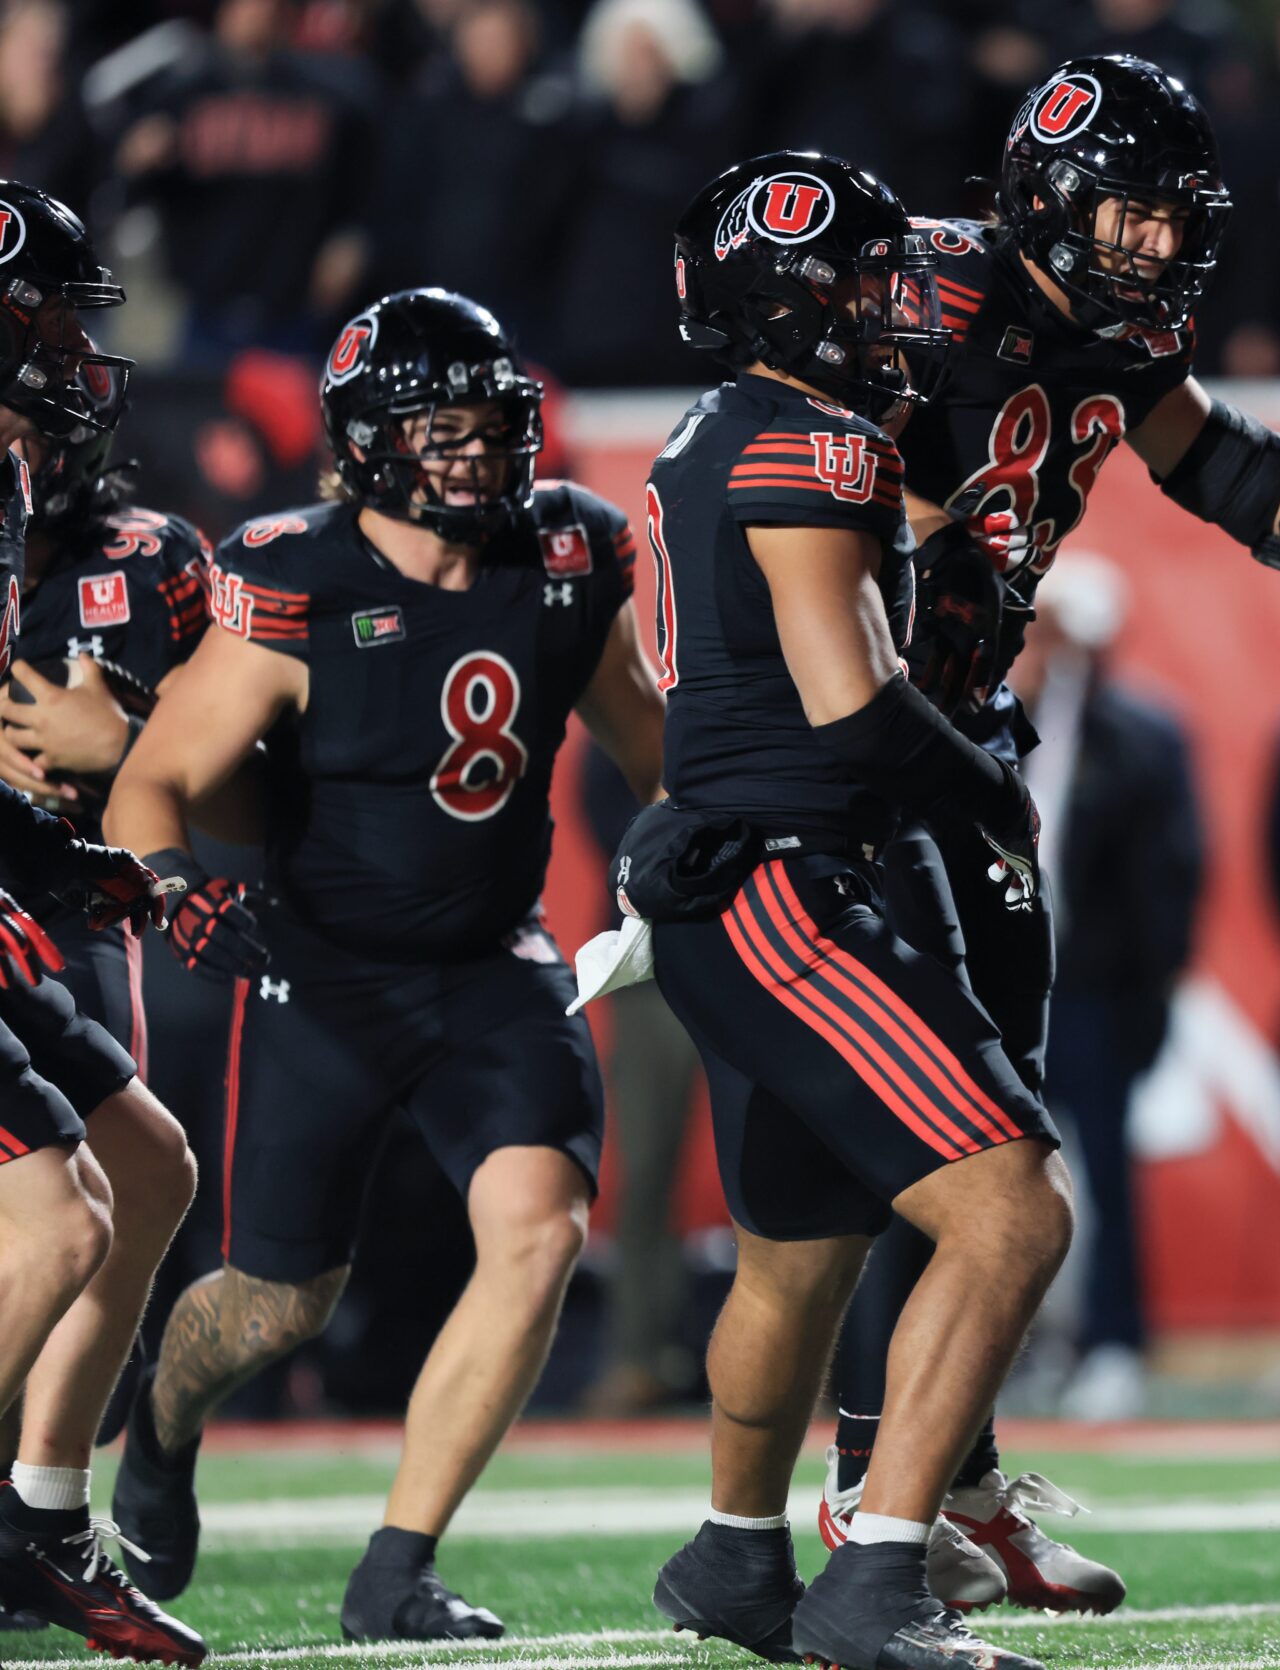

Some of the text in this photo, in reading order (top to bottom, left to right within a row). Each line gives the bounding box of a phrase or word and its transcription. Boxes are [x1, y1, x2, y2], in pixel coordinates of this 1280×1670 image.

[1038, 81, 1095, 135] U
[762, 182, 824, 235] U
[330, 326, 371, 375] U
[90, 579, 116, 605] U
[429, 650, 529, 822] 8
